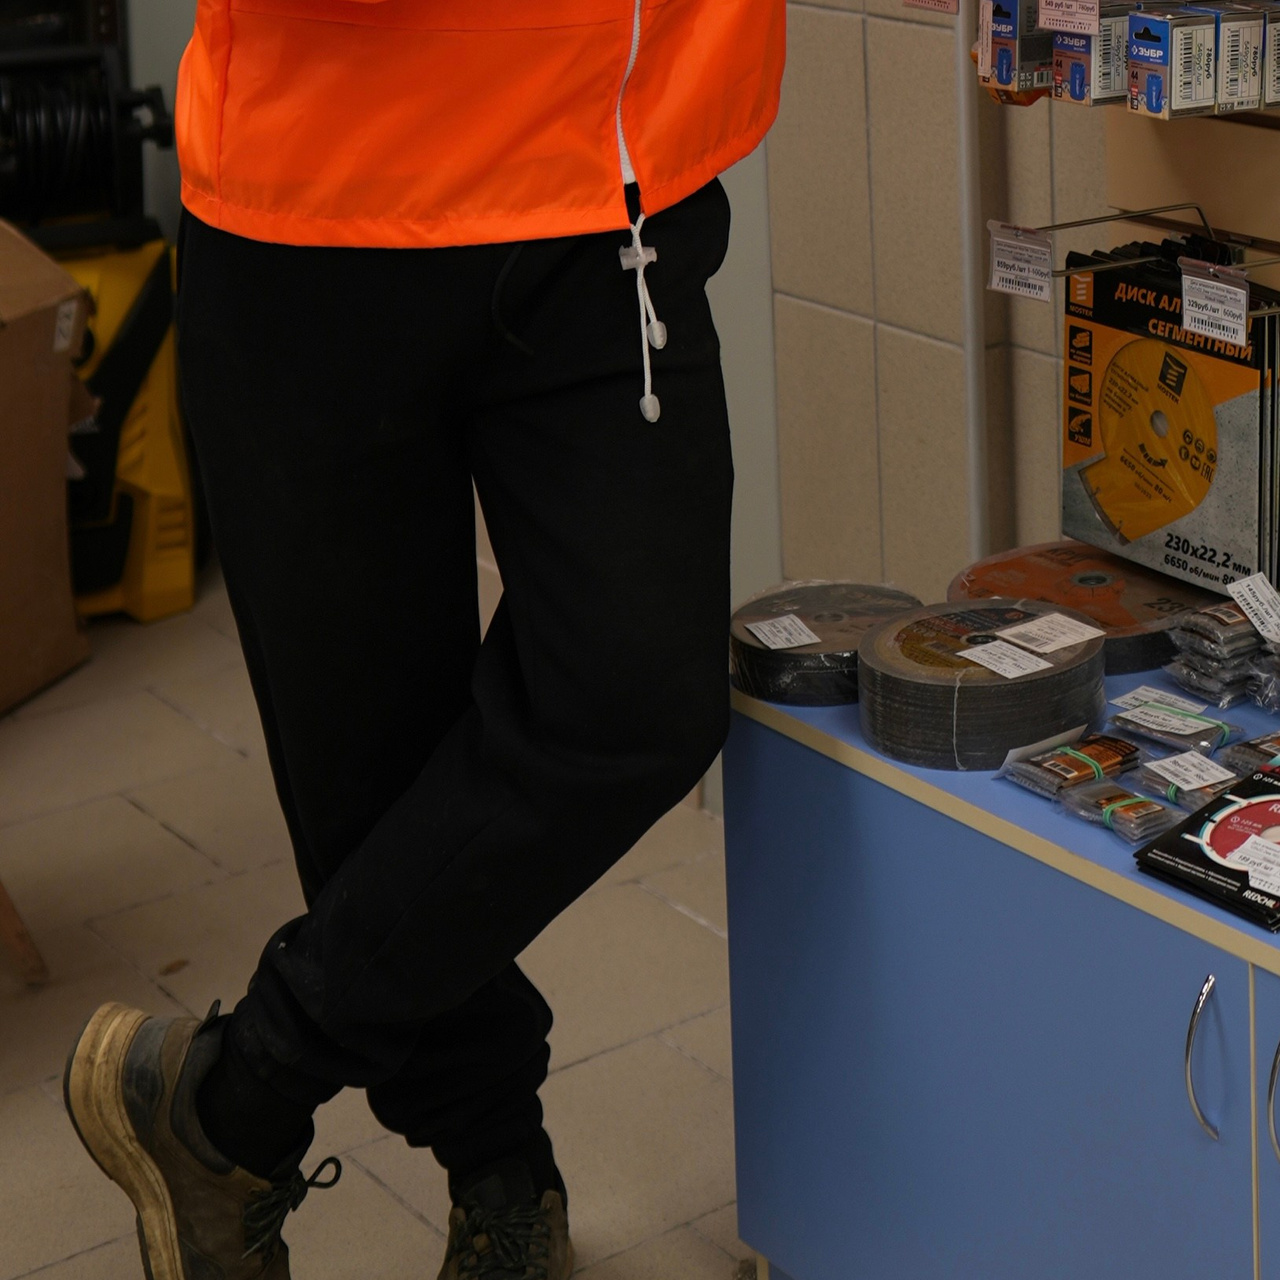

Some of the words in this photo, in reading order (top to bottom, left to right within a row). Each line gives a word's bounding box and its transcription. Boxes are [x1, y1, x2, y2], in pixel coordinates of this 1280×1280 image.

[992, 23, 1013, 33] ЗУБР
[1063, 36, 1086, 46] ЗУБР
[1138, 47, 1164, 58] ЗУБР
[1055, 59, 1063, 68] 44
[1130, 70, 1139, 80] 44
[1115, 282, 1155, 306] ДИСК
[1187, 299, 1220, 315] 329руб./шт
[1165, 533, 1231, 568] 230x22,2
[1232, 562, 1251, 576] мм
[1164, 554, 1188, 571] 6650
[1189, 566, 1220, 582] об/мин
